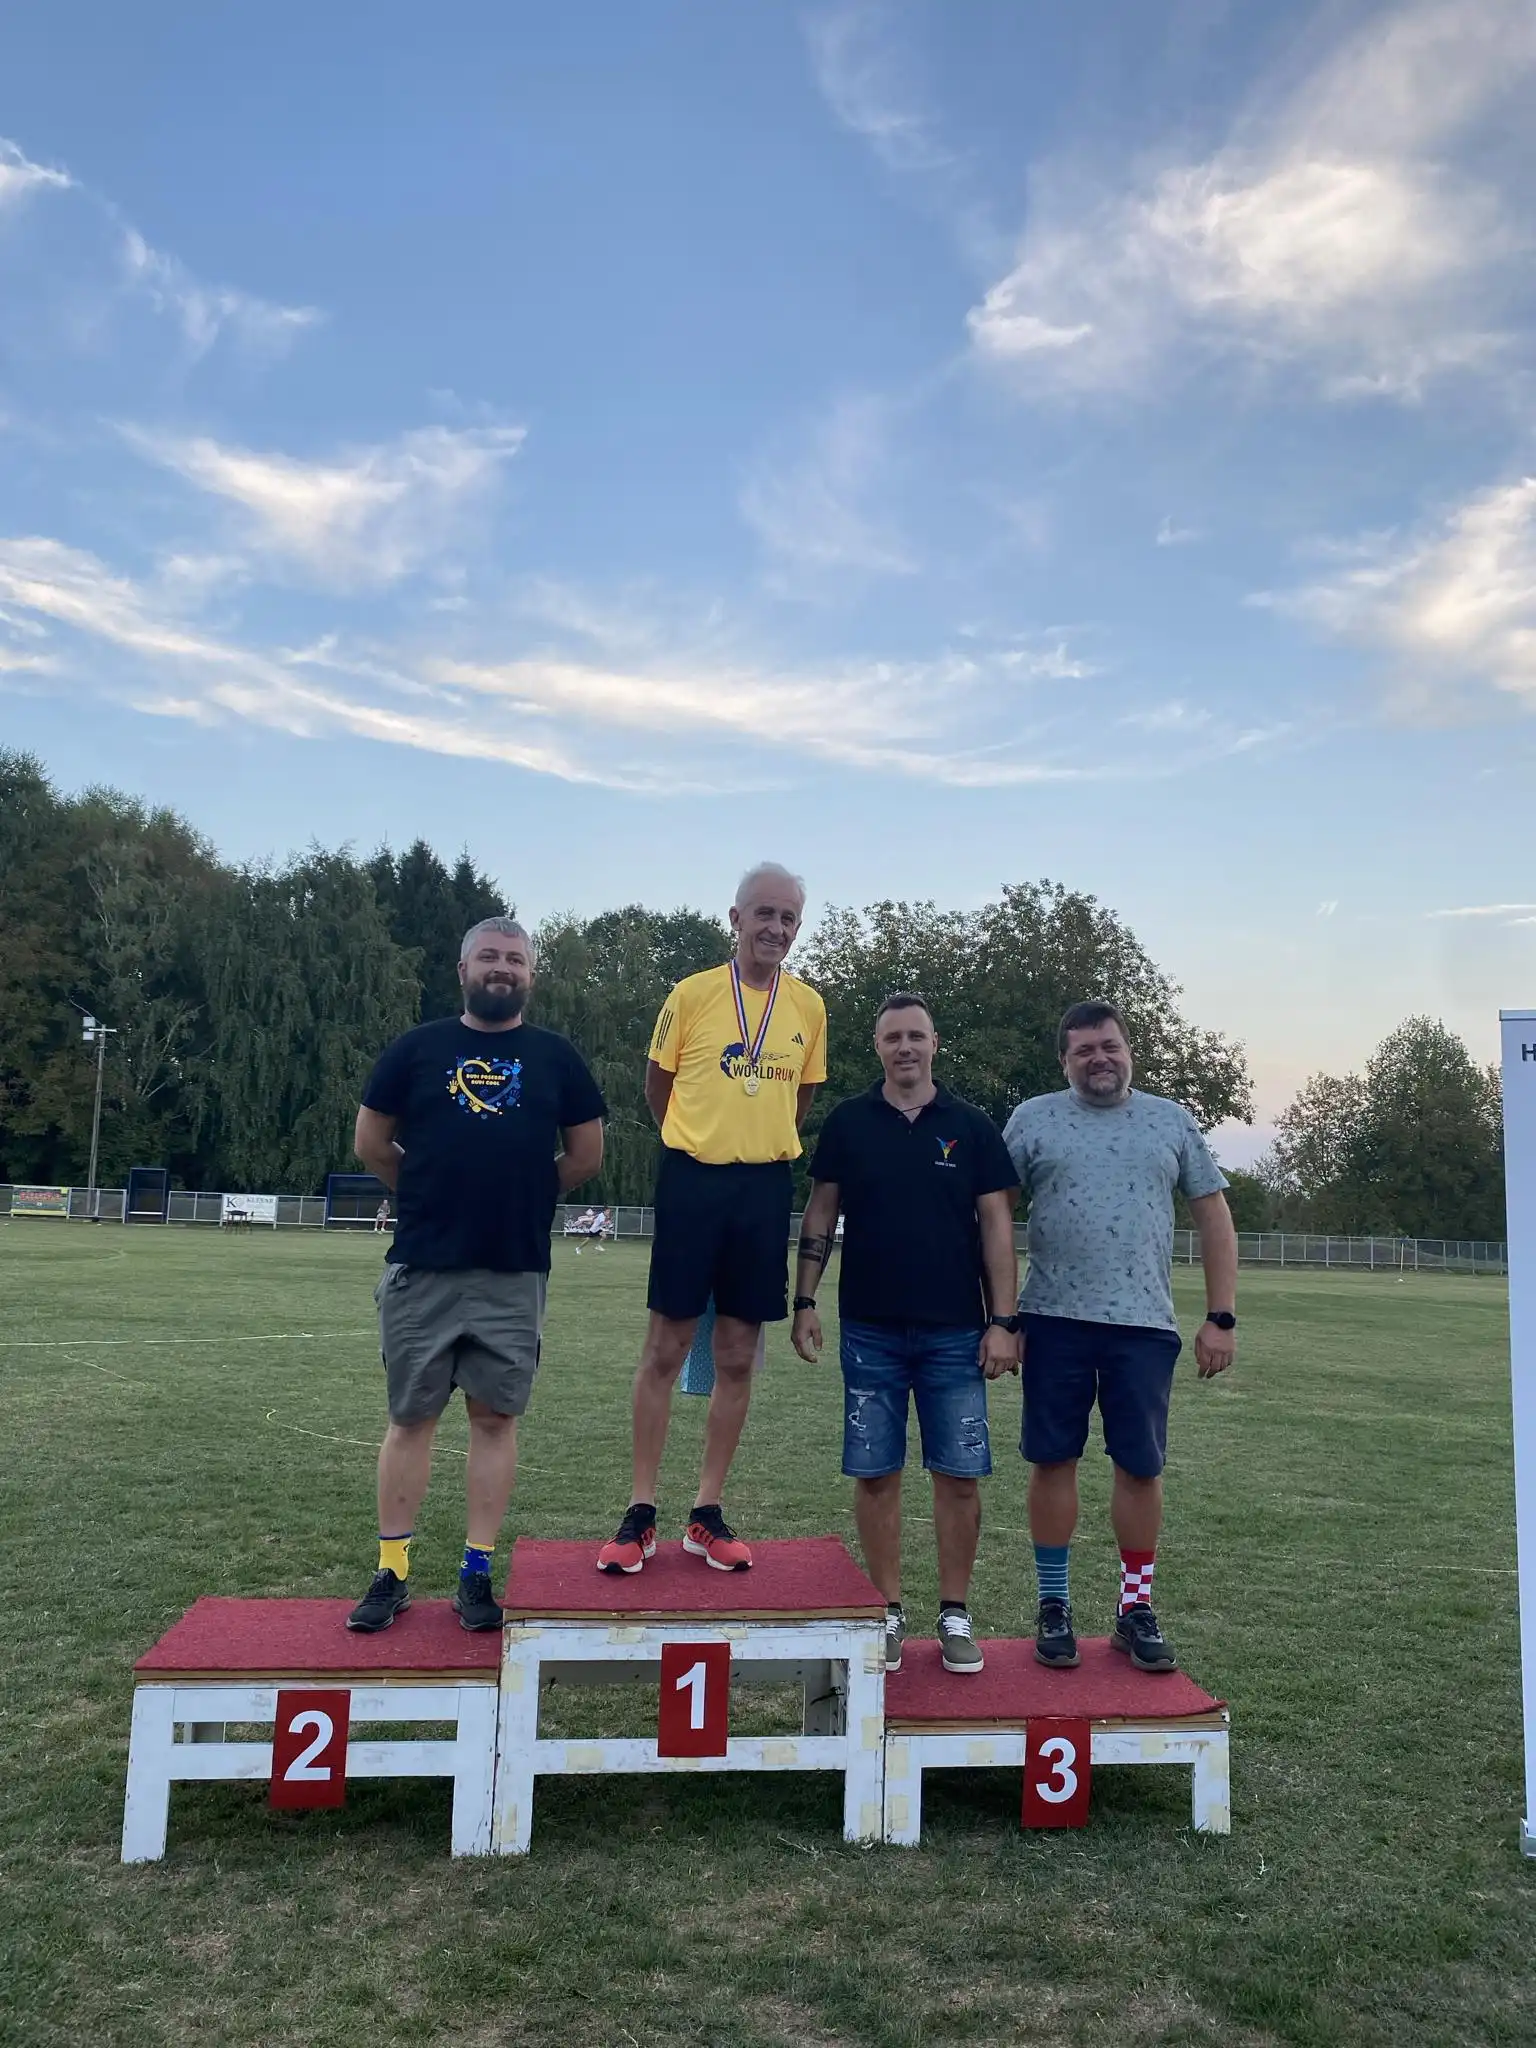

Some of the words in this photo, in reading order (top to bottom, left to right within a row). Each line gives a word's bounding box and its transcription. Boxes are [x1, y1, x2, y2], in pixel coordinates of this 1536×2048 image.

[677, 1662, 706, 1729] 1
[284, 1711, 333, 1780] 2
[1036, 1738, 1077, 1803] 3
